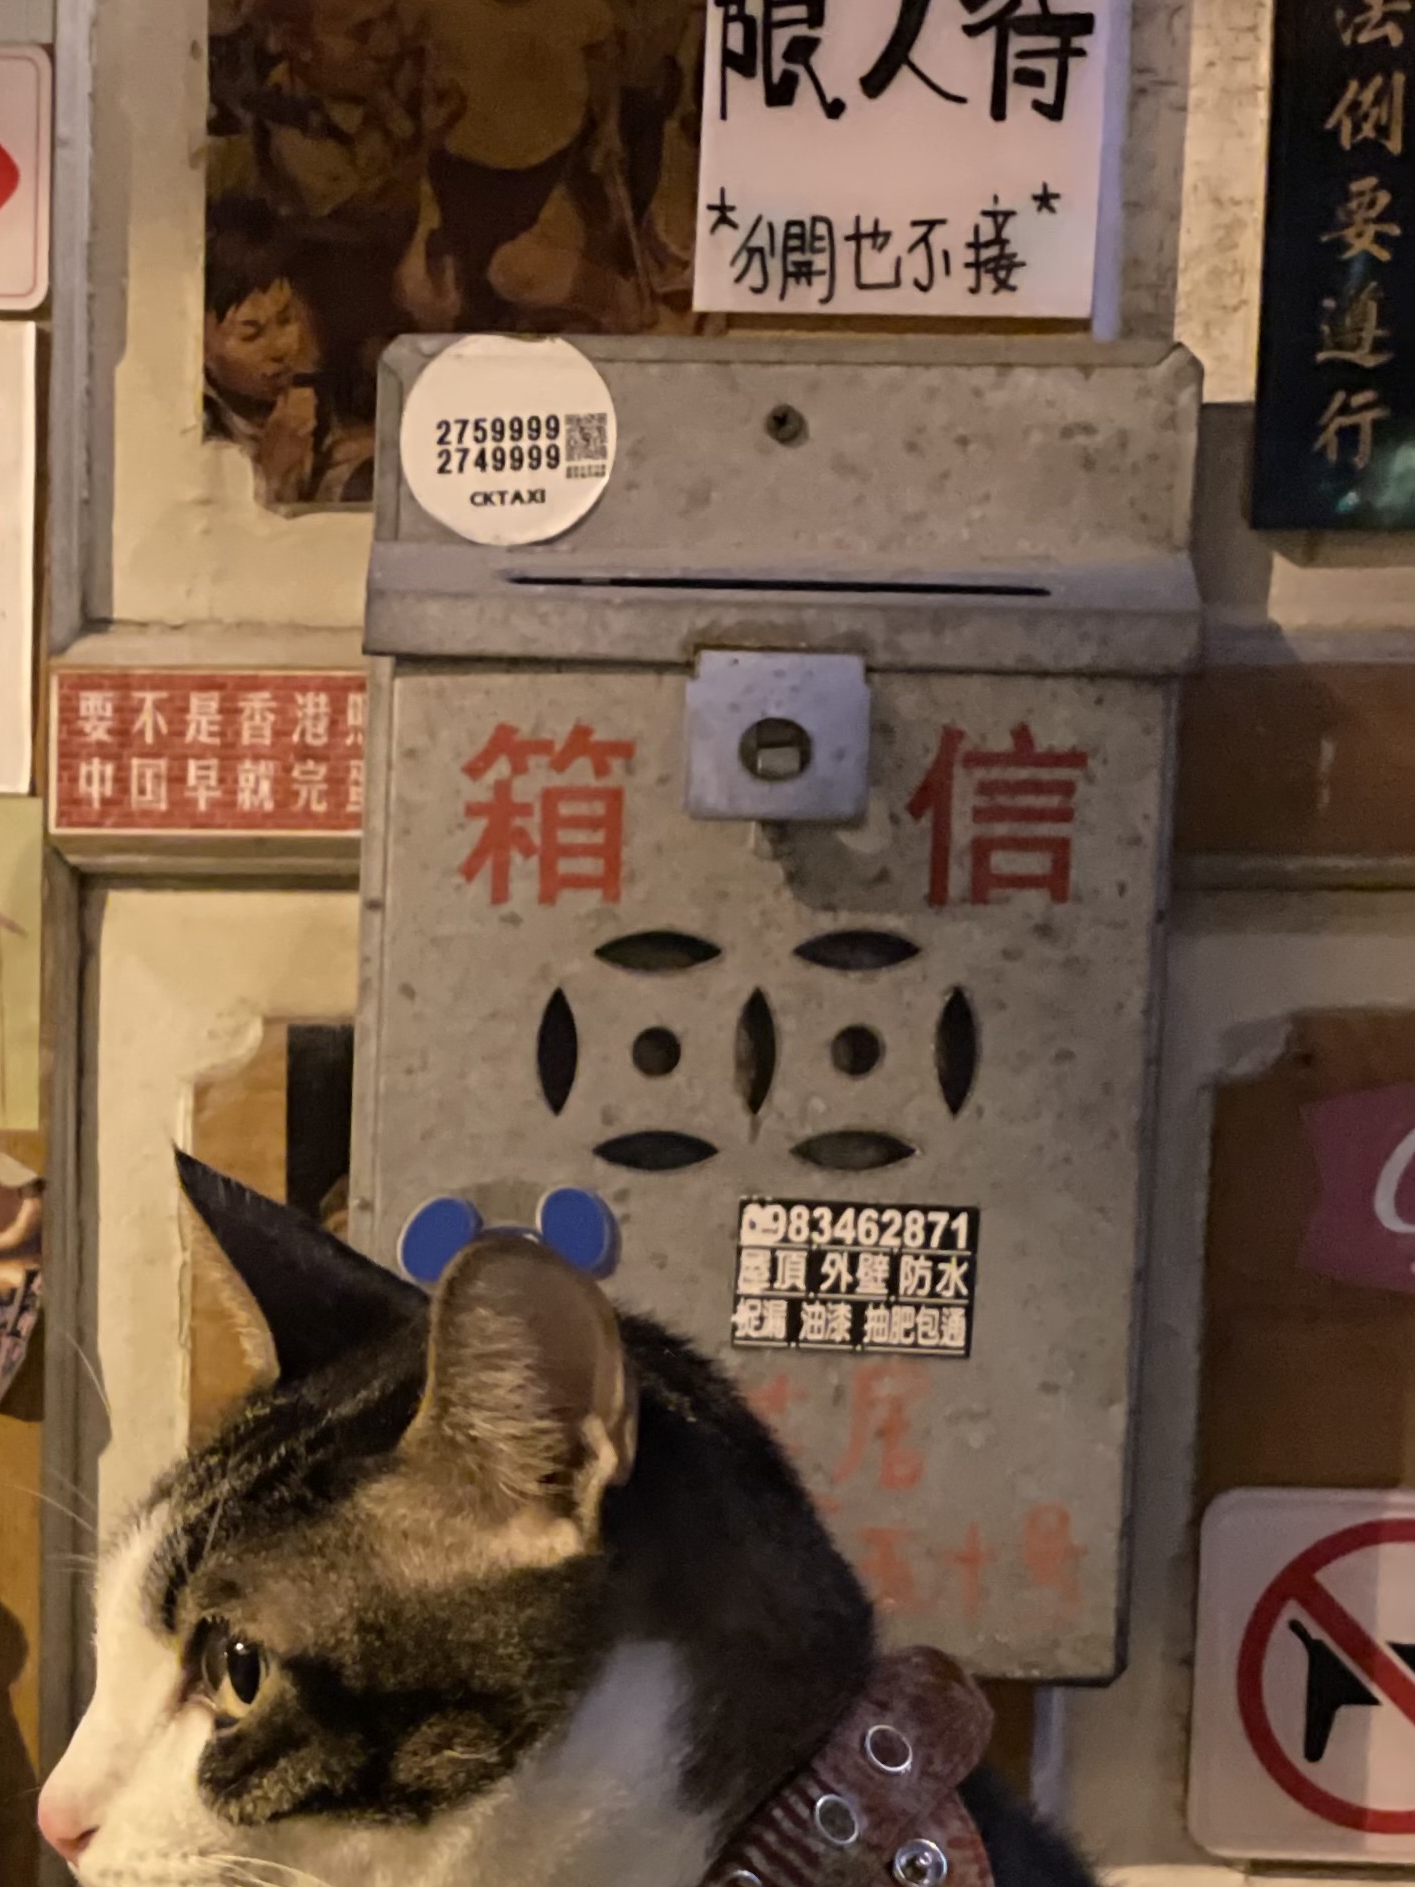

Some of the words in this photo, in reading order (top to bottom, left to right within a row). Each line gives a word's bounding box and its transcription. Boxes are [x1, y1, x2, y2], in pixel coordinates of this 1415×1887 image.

[730, 194, 1026, 304] 分開也不接
[435, 414, 560, 446] 2759999
[435, 444, 561, 474] 2749999
[899, 1254, 970, 1298] 防水
